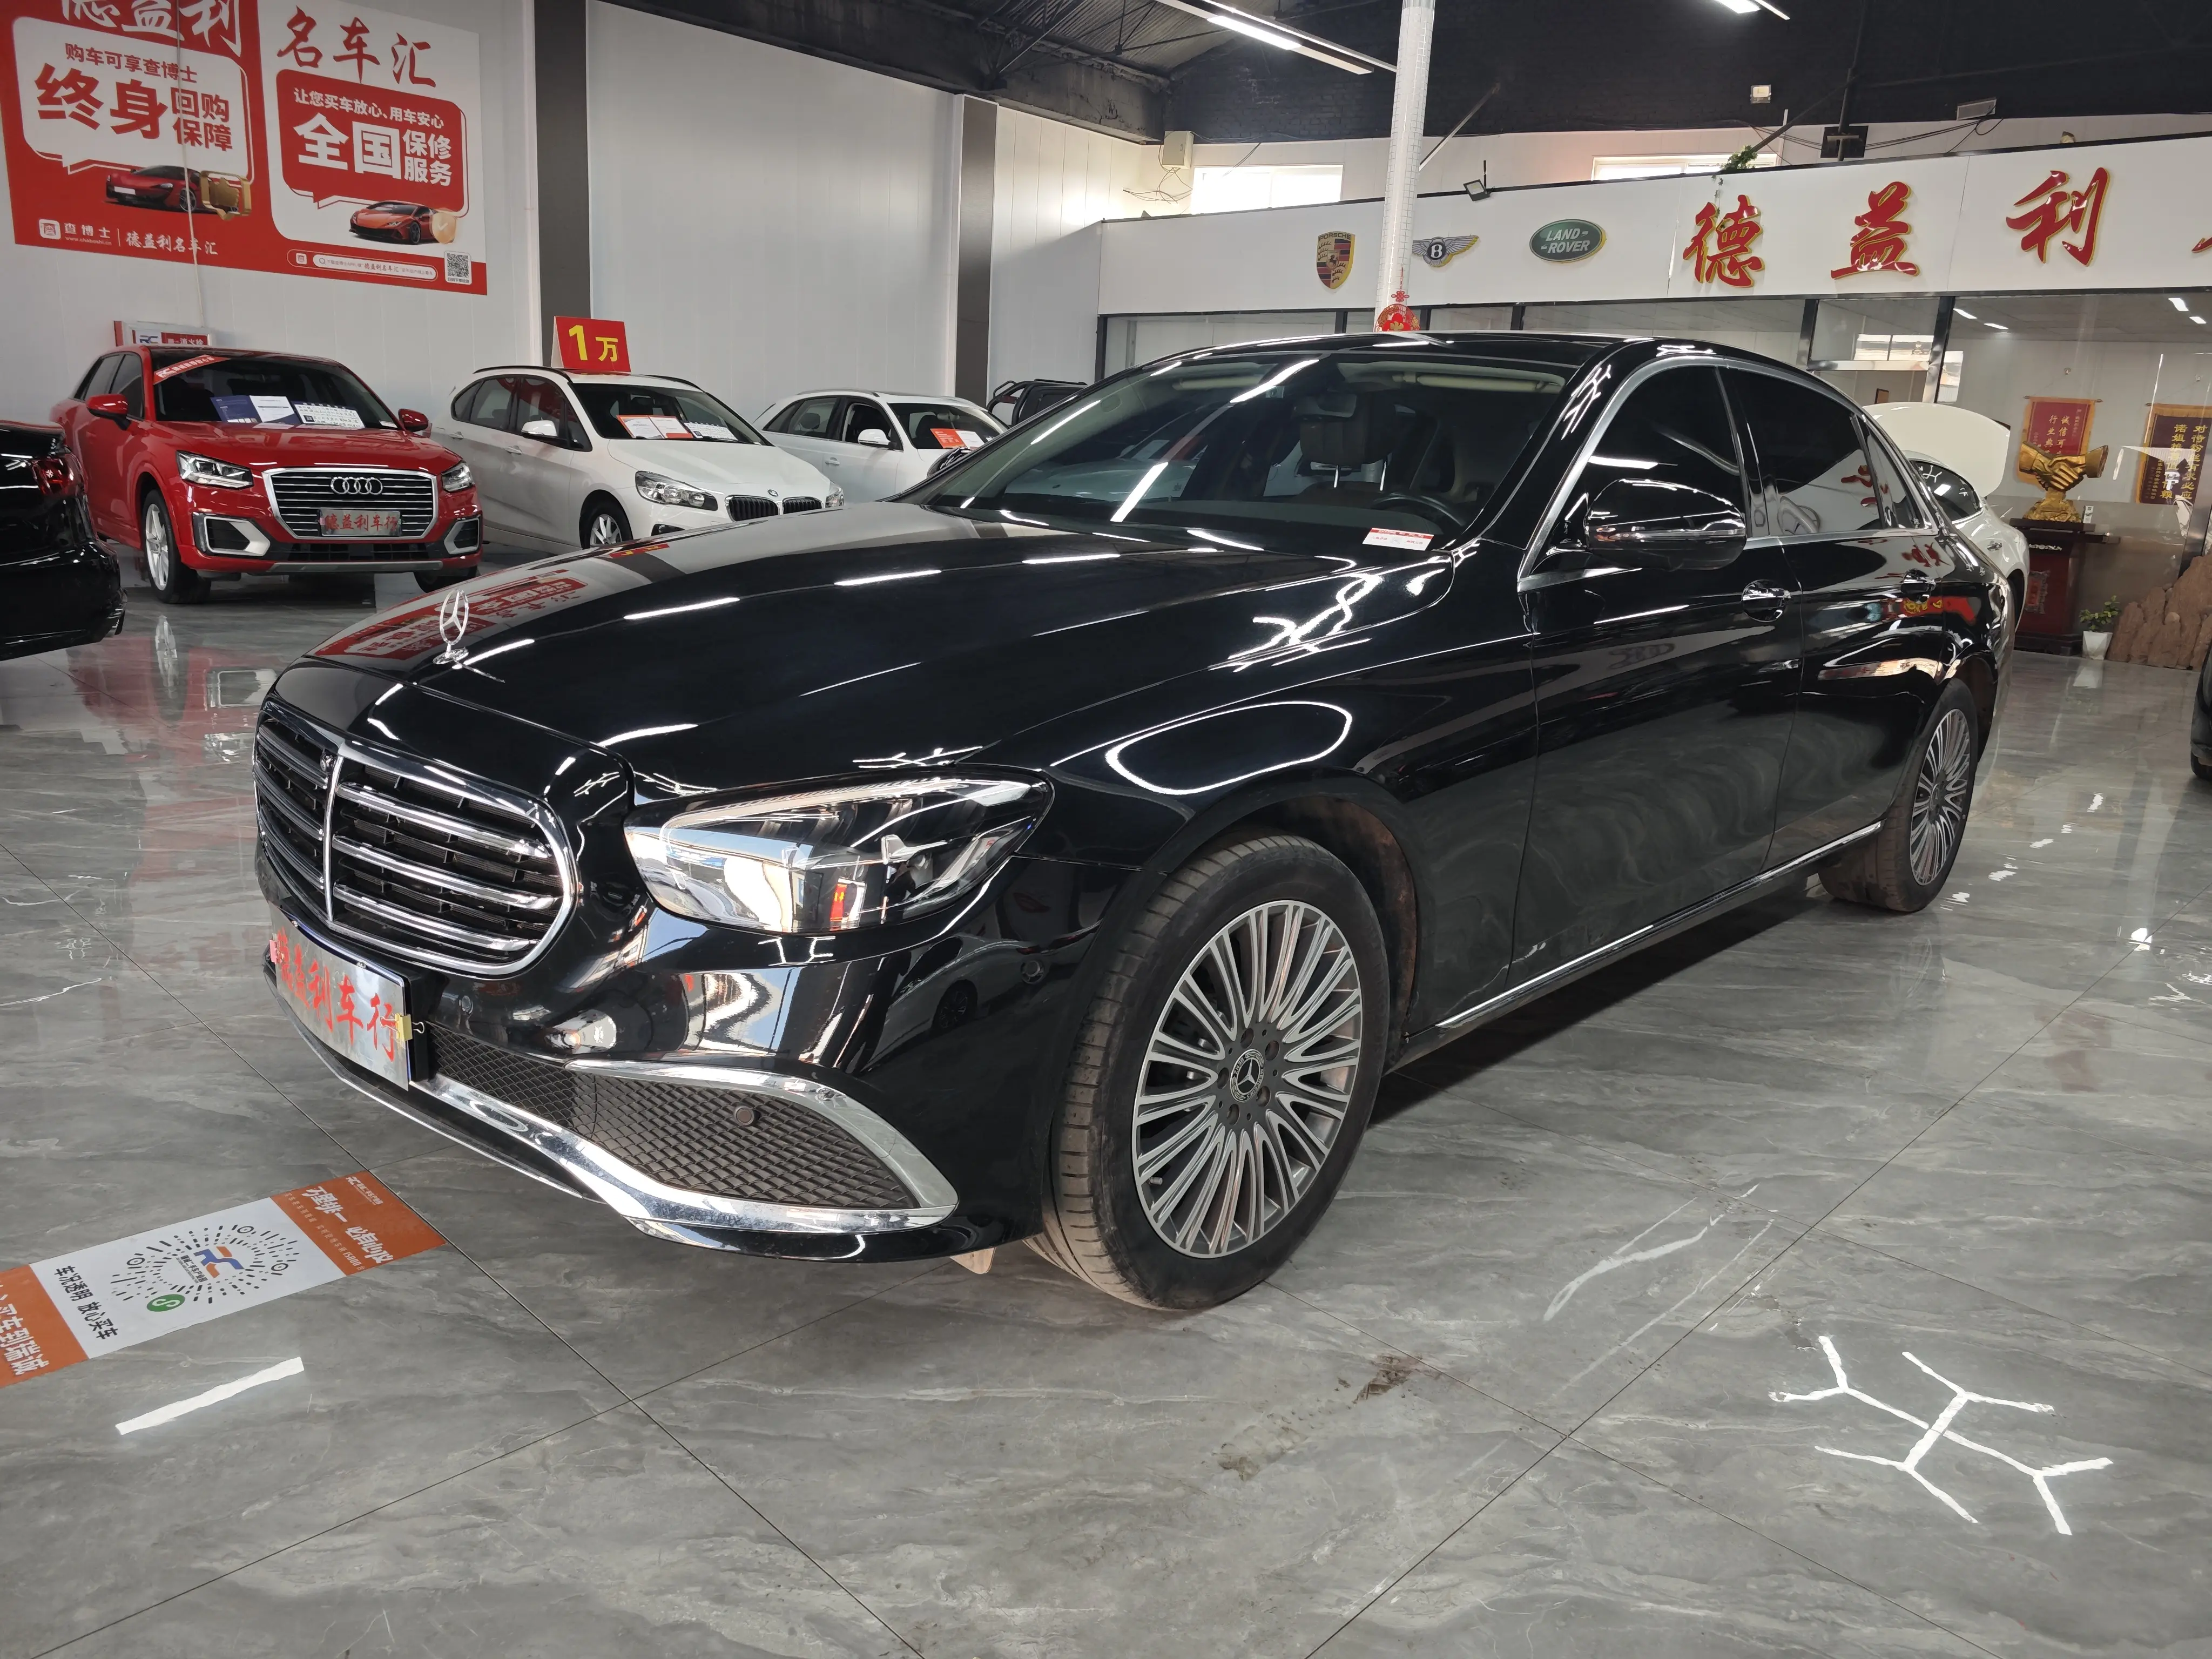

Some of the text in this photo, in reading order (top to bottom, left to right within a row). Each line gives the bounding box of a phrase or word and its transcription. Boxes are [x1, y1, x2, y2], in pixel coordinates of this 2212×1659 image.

[65, 43, 198, 84] 购车可享查博士
[276, 5, 437, 88] 名车汇
[34, 62, 168, 140] 终身
[170, 88, 231, 123] 回购
[293, 87, 444, 129] 让您买车放心、用车安心
[173, 117, 233, 152] 保障
[293, 113, 401, 180] 全国
[402, 129, 452, 161] 保修
[404, 158, 452, 187] 服务
[64, 222, 111, 239] 查博士
[126, 231, 218, 255] 德益利名车汇
[1319, 232, 1351, 241] PORSCHE
[1682, 166, 2212, 288] 德益利
[569, 325, 618, 362] 1万
[2044, 414, 2058, 454] 行业典
[2056, 415, 2071, 455] 诚信可
[325, 513, 399, 532] 德益利车行
[276, 926, 399, 1063] 德益利车行
[1233, 1057, 1245, 1075] BENZ
[301, 1186, 348, 1223] 万里挑一
[54, 1265, 118, 1340] 车况透明 放心买车
[0, 1284, 50, 1375] 买车到瑞诚
